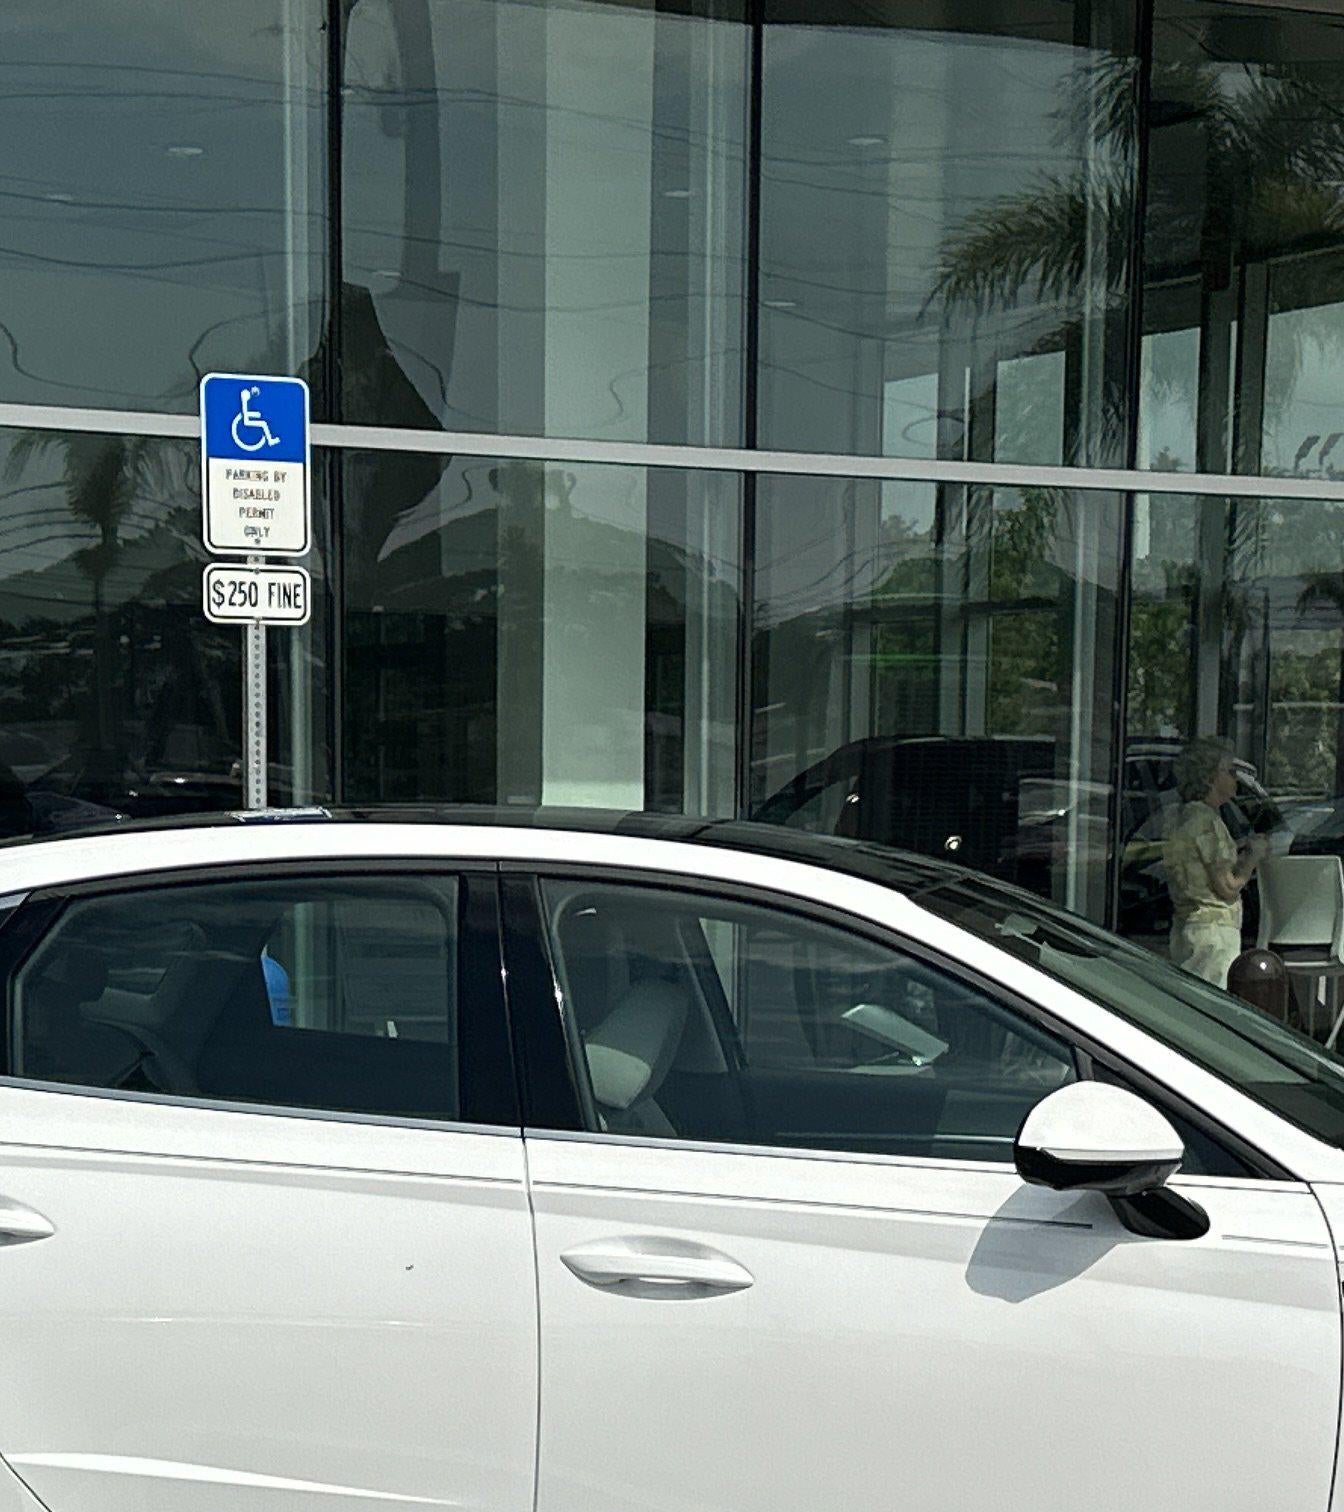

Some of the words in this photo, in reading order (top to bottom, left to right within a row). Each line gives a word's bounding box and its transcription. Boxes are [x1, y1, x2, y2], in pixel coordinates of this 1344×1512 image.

[273, 471, 287, 483] BY
[232, 487, 281, 501] DISABLED
[238, 506, 275, 519] PERMIT
[243, 526, 271, 538] ONLY
[211, 578, 258, 609] $250
[267, 581, 303, 609] FINE
